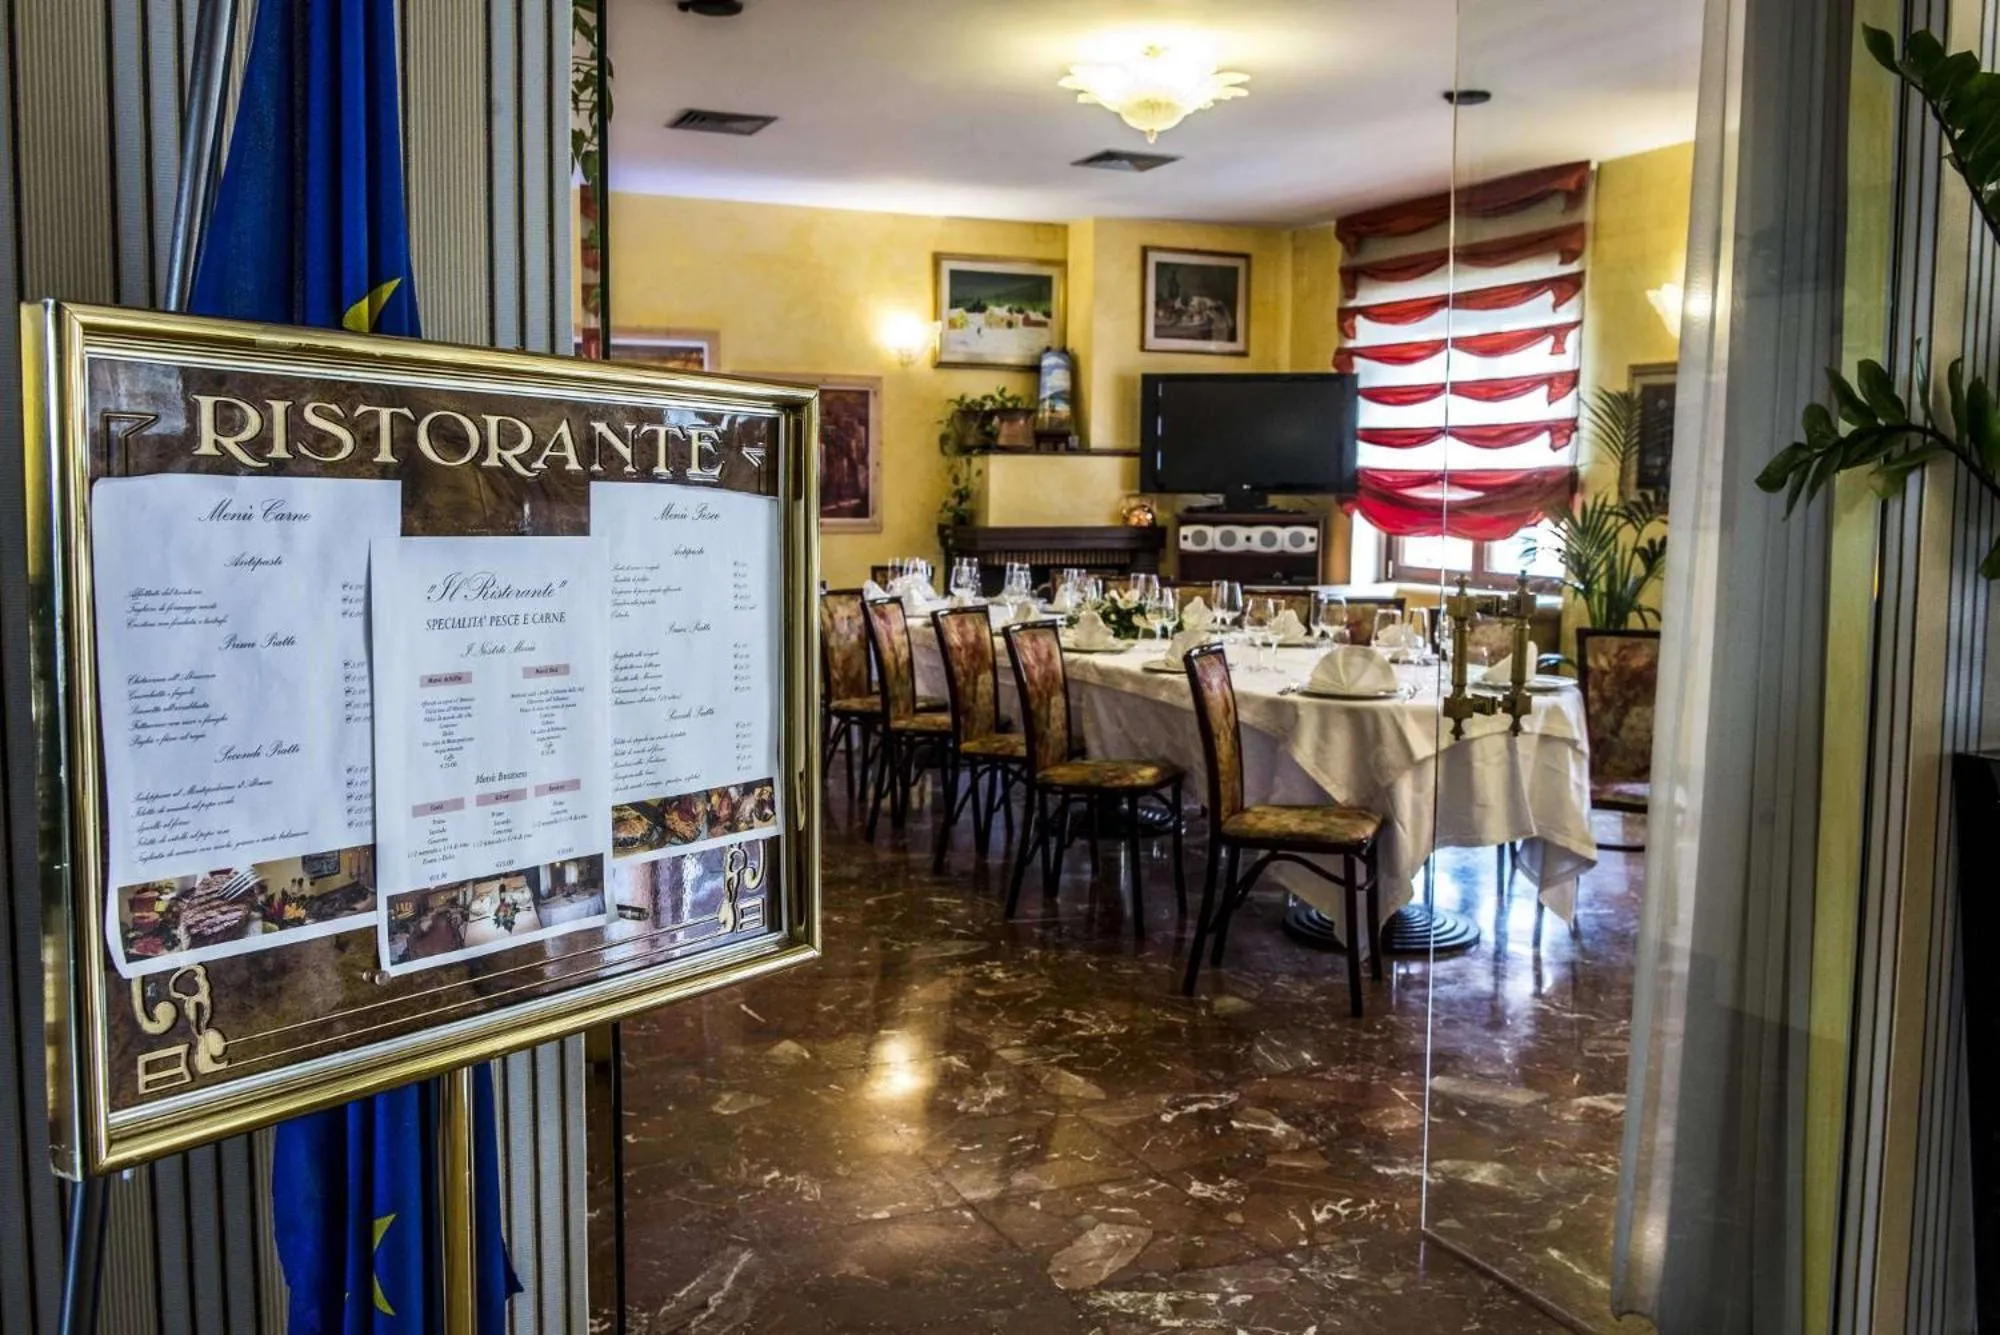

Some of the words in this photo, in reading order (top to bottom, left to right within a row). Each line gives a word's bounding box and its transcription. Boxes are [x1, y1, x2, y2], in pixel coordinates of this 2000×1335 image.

[191, 394, 727, 481] RISTORANTE
[260, 498, 312, 522] Carne
[425, 615, 487, 632] SPECIALITA'
[489, 613, 520, 627] PESCE
[522, 612, 529, 625] E
[531, 611, 566, 625] CARNE
